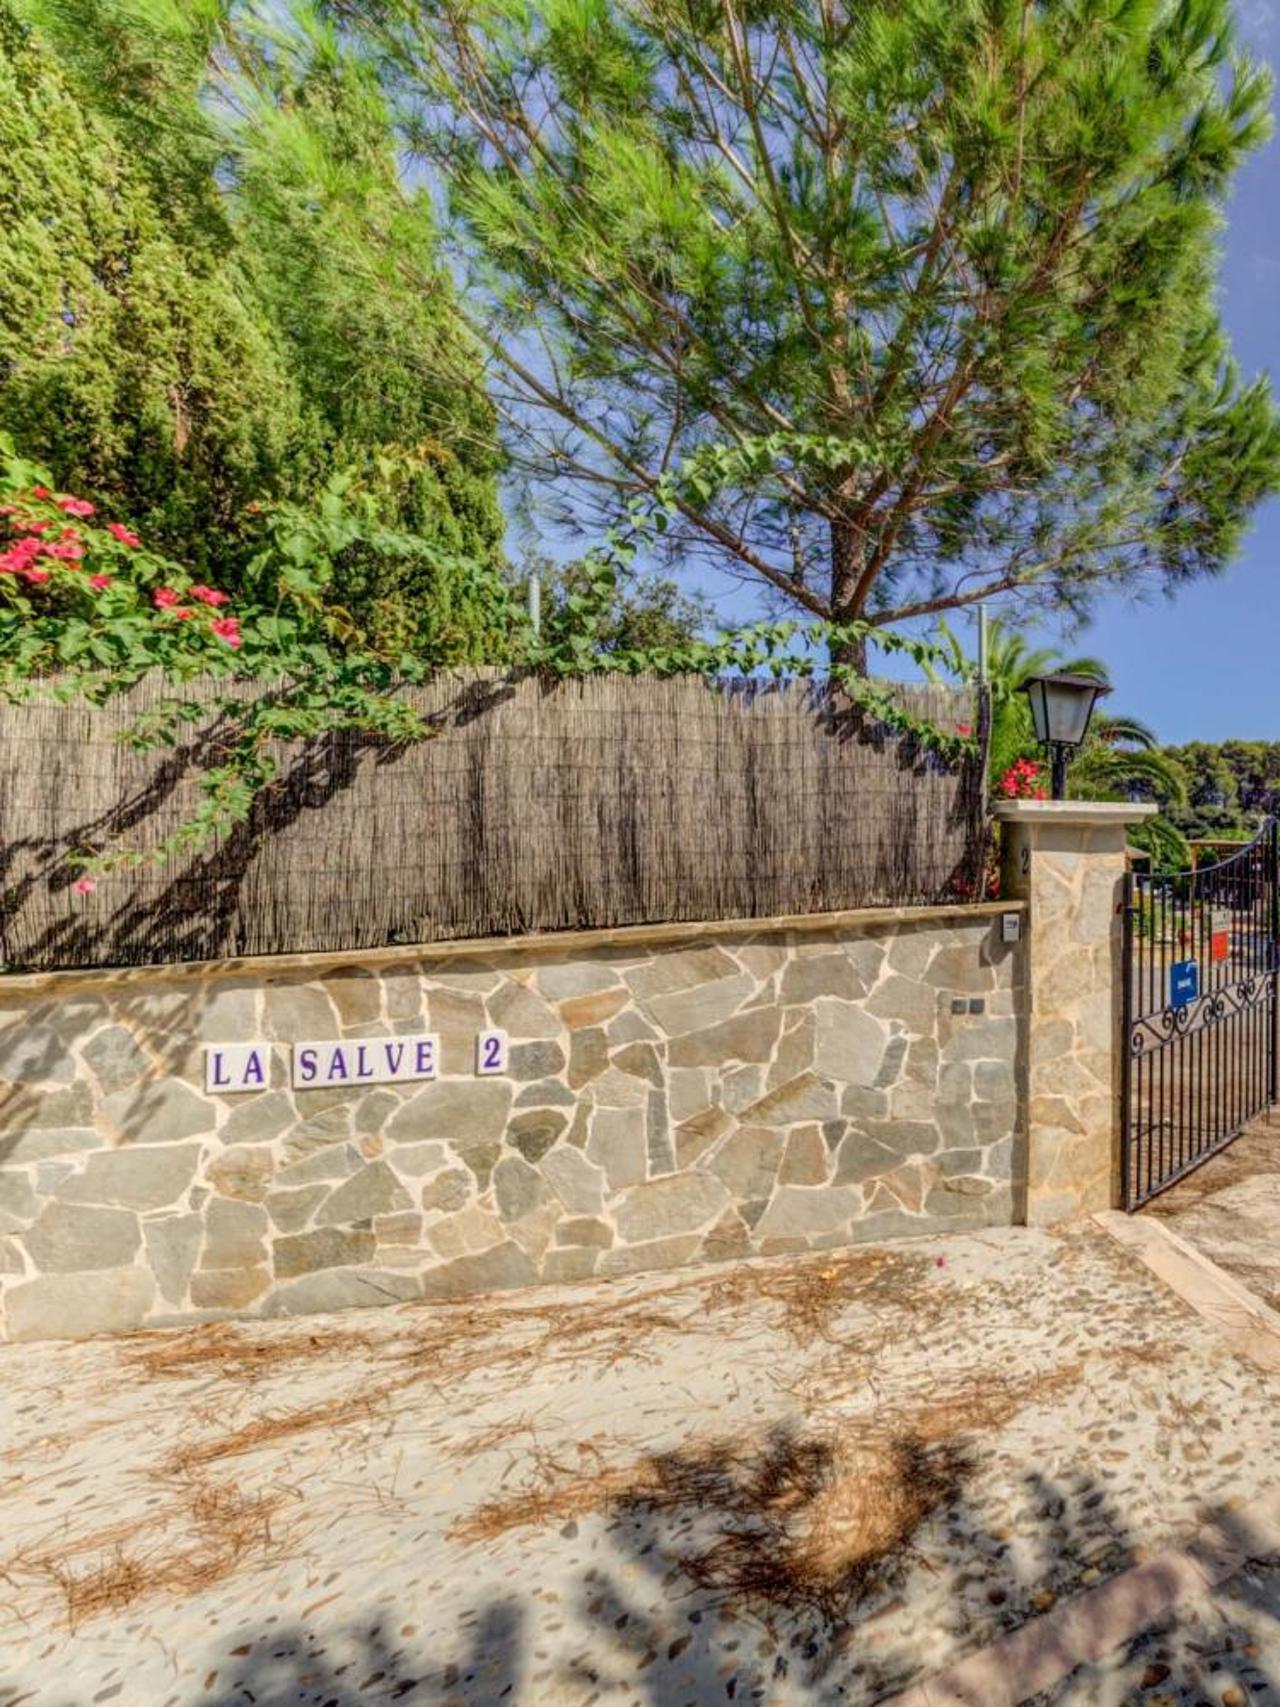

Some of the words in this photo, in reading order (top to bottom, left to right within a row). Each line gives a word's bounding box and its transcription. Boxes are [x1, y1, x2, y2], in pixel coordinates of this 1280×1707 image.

[213, 1051, 264, 1085] LA
[300, 1041, 433, 1081] SALVE
[483, 1037, 501, 1068] 2
